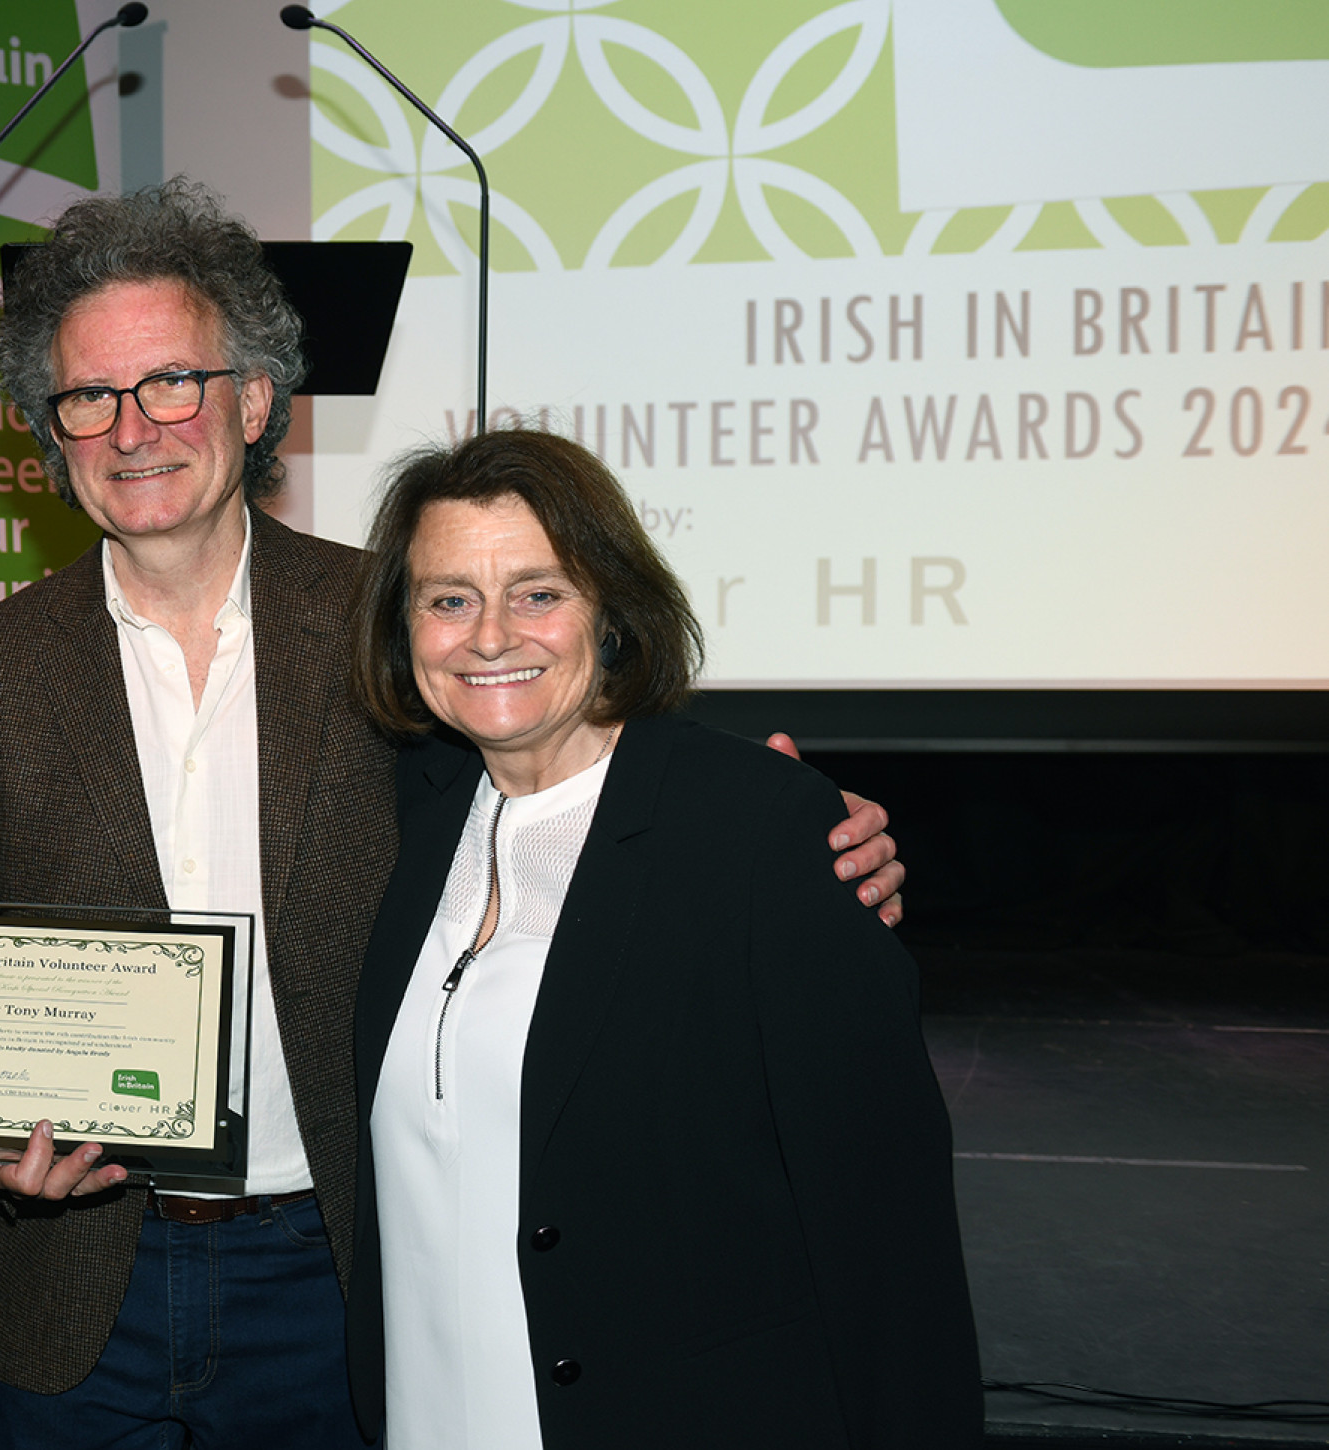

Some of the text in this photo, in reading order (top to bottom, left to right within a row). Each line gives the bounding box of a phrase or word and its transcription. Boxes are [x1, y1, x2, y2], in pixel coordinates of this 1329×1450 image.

[745, 280, 1329, 366] IRISH IN BRITAI
[857, 388, 1144, 463] AWARDS
[1180, 385, 1329, 458] 202
[815, 555, 969, 627] HR
[39, 958, 108, 973] Volunteer
[111, 962, 157, 974] Award
[4, 1004, 40, 1018] Tony
[44, 1006, 97, 1021] Murray
[118, 1073, 137, 1081] Irish
[127, 1082, 155, 1090] Britain
[150, 1105, 170, 1114] HR
